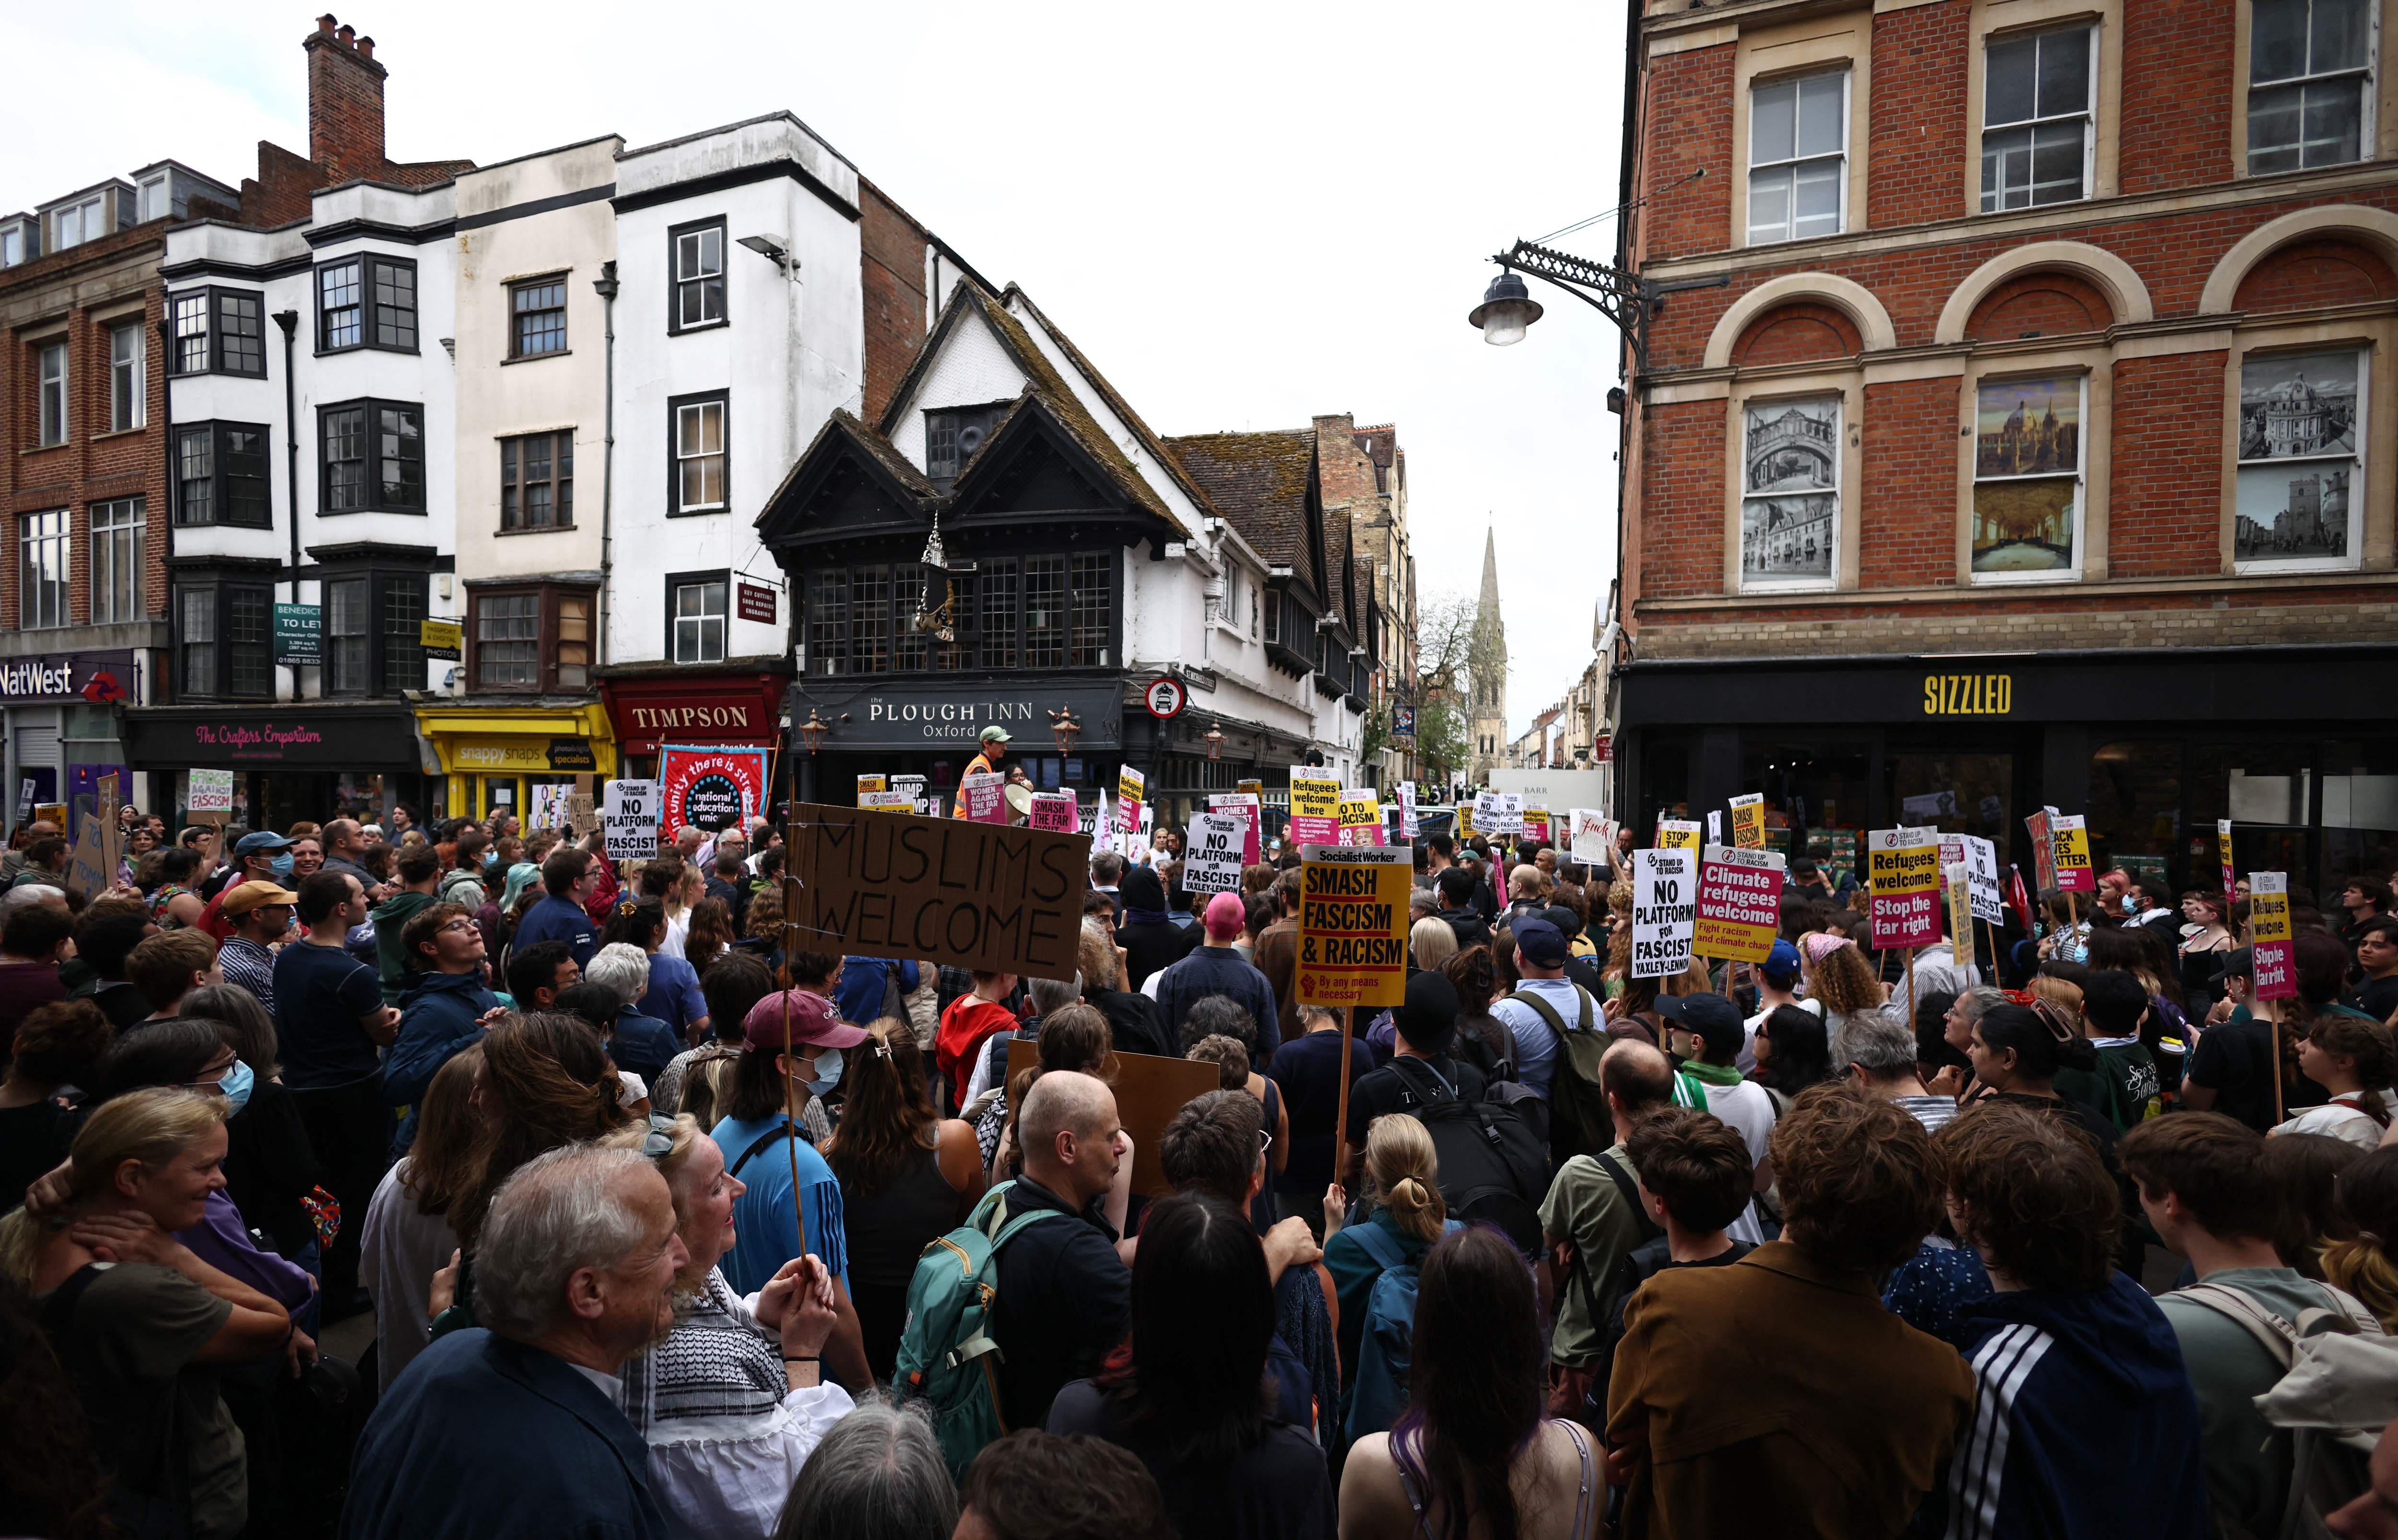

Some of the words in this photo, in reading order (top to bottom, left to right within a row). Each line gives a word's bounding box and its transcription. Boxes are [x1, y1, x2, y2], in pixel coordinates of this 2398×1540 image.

[754, 591, 773, 600] CUTTING
[755, 600, 774, 610] REPAIRS
[745, 608, 771, 618] ENGRAVING
[282, 619, 298, 627] TO
[302, 620, 321, 629] LET
[426, 626, 456, 635] PASSPORT
[433, 635, 456, 643] DIGITAL
[426, 648, 457, 658] PHOTOS
[0, 661, 71, 695] NatWest
[1924, 675, 2011, 714] SIZZLED
[632, 706, 748, 728] TIMPSON
[870, 704, 975, 720] PLOUGH
[988, 703, 1032, 719] INN
[196, 726, 216, 743] The
[219, 725, 261, 749] Crafters
[264, 724, 321, 749] Emporium
[923, 725, 976, 737] Oxford
[554, 755, 590, 765] specialists
[194, 770, 228, 786] FROGS
[670, 773, 689, 813] unity
[688, 757, 723, 776] there
[724, 757, 734, 772] is
[1120, 776, 1142, 794] Refugees
[192, 784, 230, 795] AGAINST
[541, 785, 562, 800] ONE
[970, 786, 996, 796] WOMEN
[1293, 780, 1337, 794] Refugees
[191, 794, 230, 809] FASCISM
[695, 791, 731, 802] national
[970, 792, 1000, 803] AGAINST
[1120, 787, 1140, 802] welcome
[1294, 794, 1335, 804] welcome
[537, 799, 555, 814] ONE
[570, 798, 581, 813] NO
[622, 799, 641, 814] NO
[693, 801, 734, 813] education
[971, 802, 985, 811] THE
[986, 800, 998, 809] FAR
[1034, 801, 1065, 814] SMASH
[1118, 796, 1132, 810] Black
[1303, 804, 1324, 815] here
[1350, 803, 1364, 813] TO
[1481, 802, 1491, 810] NO
[971, 808, 992, 818] RIGHT
[1118, 805, 1130, 818] Lives
[1215, 806, 1247, 815] WOMEN
[1473, 808, 1498, 818] PLATFORM
[1734, 807, 1753, 825] SMASH
[537, 814, 554, 829] ONE
[607, 816, 655, 827] PLATFORM
[1034, 813, 1049, 825] THE
[1052, 814, 1069, 826] FAR
[1117, 814, 1132, 828] Matter
[1472, 818, 1497, 828] FASCIST
[626, 828, 636, 836] FOR
[1666, 832, 1689, 840] STOP
[1736, 825, 1760, 845] FASCISM
[607, 837, 655, 848] FASCIST
[1206, 833, 1227, 850] NO
[1666, 840, 1681, 848] THE
[815, 813, 1071, 903] MUSLIMS
[1188, 847, 1242, 864] PLATFORM
[1319, 850, 1362, 862] Socialist
[1363, 851, 1396, 862] Worker
[1659, 858, 1675, 867] STAND
[1737, 851, 1756, 860] STAND
[1874, 853, 1935, 871] Refugees
[1939, 852, 1962, 860] AGAINST
[2056, 854, 2087, 866] ATTER
[1665, 866, 1683, 874] RACISM
[1746, 859, 1768, 868] RACISM
[1186, 869, 1239, 885] FASCIST
[1305, 867, 1377, 895] SMASH
[1705, 865, 1770, 889] Climate
[1874, 872, 1932, 889] welcome
[1186, 882, 1238, 895] YAXLEY-LENNON
[1654, 880, 1678, 904] NO
[1703, 885, 1777, 907] refugees
[1970, 893, 1999, 913] FASCIST
[1702, 903, 1775, 924] welcome
[1875, 899, 1910, 918] Stop
[1912, 895, 1931, 912] the
[1304, 902, 1392, 930] FASCISM
[1636, 905, 1693, 925] PLATFORM
[814, 887, 1061, 967] WELCOME
[1659, 925, 1673, 939] FOR
[1698, 922, 1720, 933] Fight
[1722, 926, 1751, 937] racism
[1875, 919, 1899, 935] far
[1903, 915, 1931, 936] right
[1636, 938, 1692, 960] FASCIST
[1697, 934, 1713, 943] and
[1716, 936, 1746, 948] climate
[1748, 940, 1770, 951] chaos
[1301, 936, 1317, 963] &
[1325, 938, 1403, 964] RACISM
[1635, 957, 1689, 975] YAXLEY-LENNON
[1319, 975, 1330, 987] By
[1333, 978, 1350, 989] any
[1351, 977, 1379, 987] means
[1319, 989, 1363, 1001] necessary
